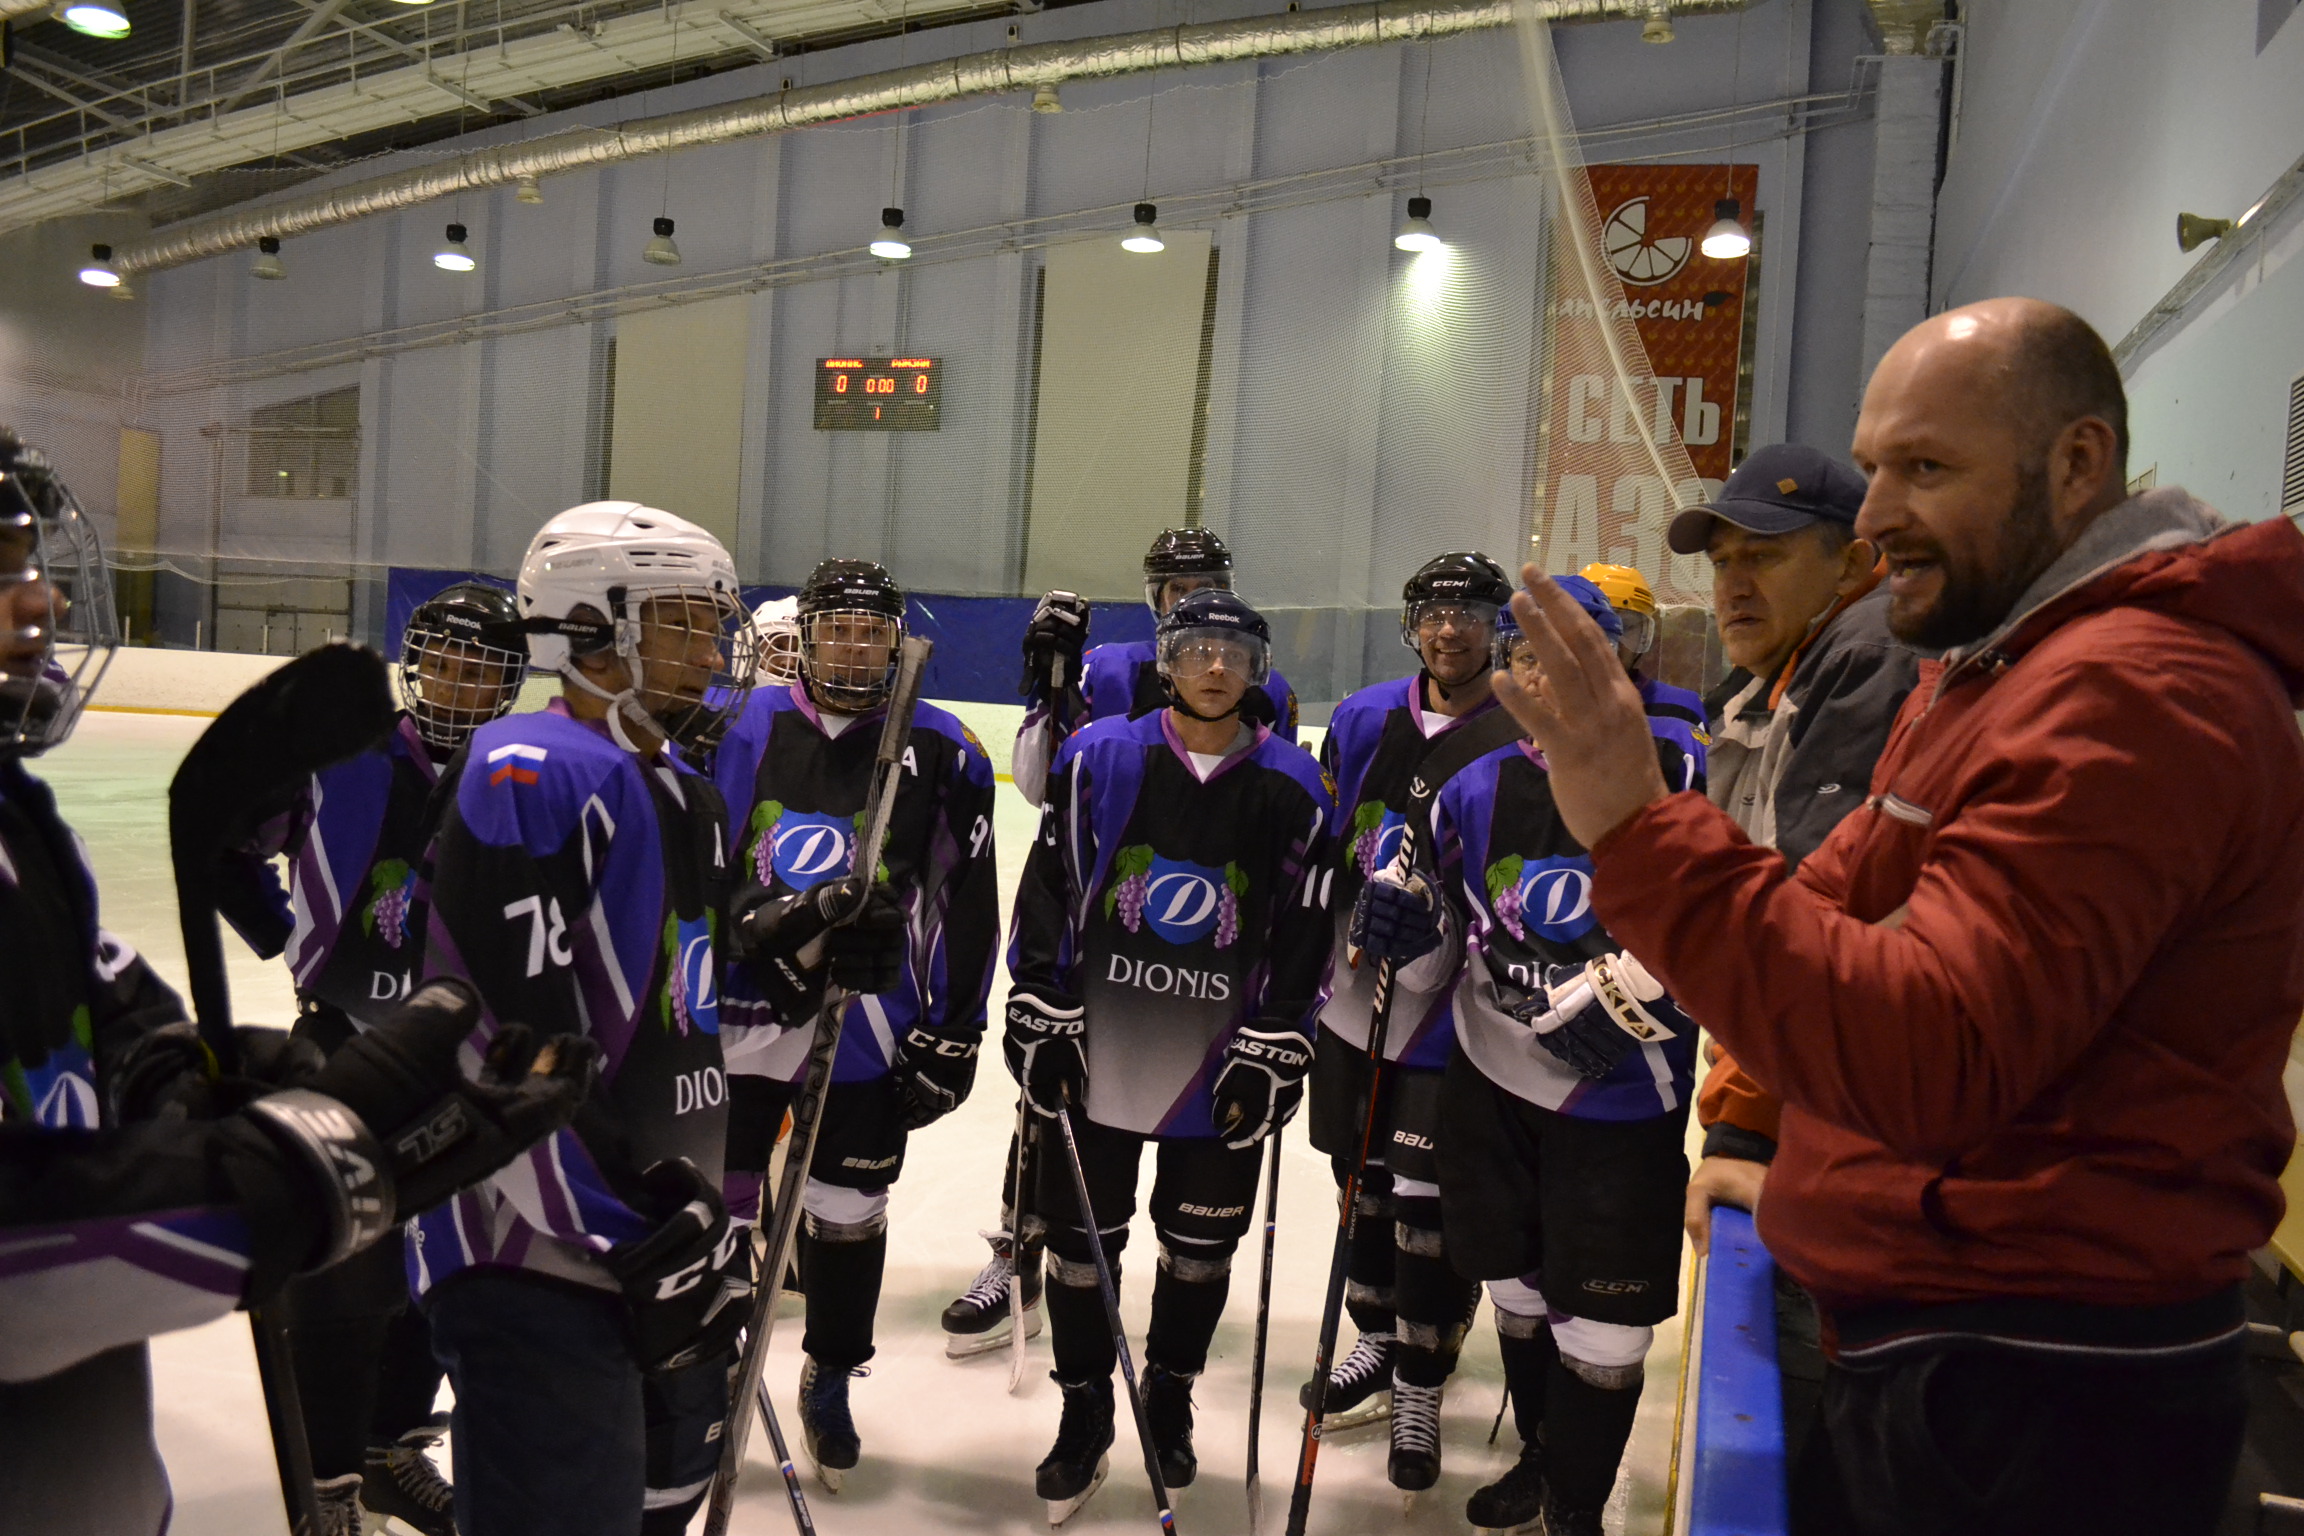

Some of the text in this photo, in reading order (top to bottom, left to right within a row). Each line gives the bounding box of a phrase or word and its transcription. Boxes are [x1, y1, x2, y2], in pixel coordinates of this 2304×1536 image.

[836, 375, 848, 393] 0
[916, 375, 929, 393] 0
[1566, 374, 1721, 446] СЕТЬ
[1432, 580, 1465, 588] CCM
[446, 614, 482, 631] Reebok
[1208, 612, 1240, 623] Reebok
[901, 745, 919, 777] A
[1106, 953, 1231, 1001] DIONIS
[1008, 1006, 1085, 1036] EASTO
[787, 993, 846, 1168] VAPOR
[841, 1154, 898, 1170] BAUER
[1178, 1202, 1245, 1218] BAUER
